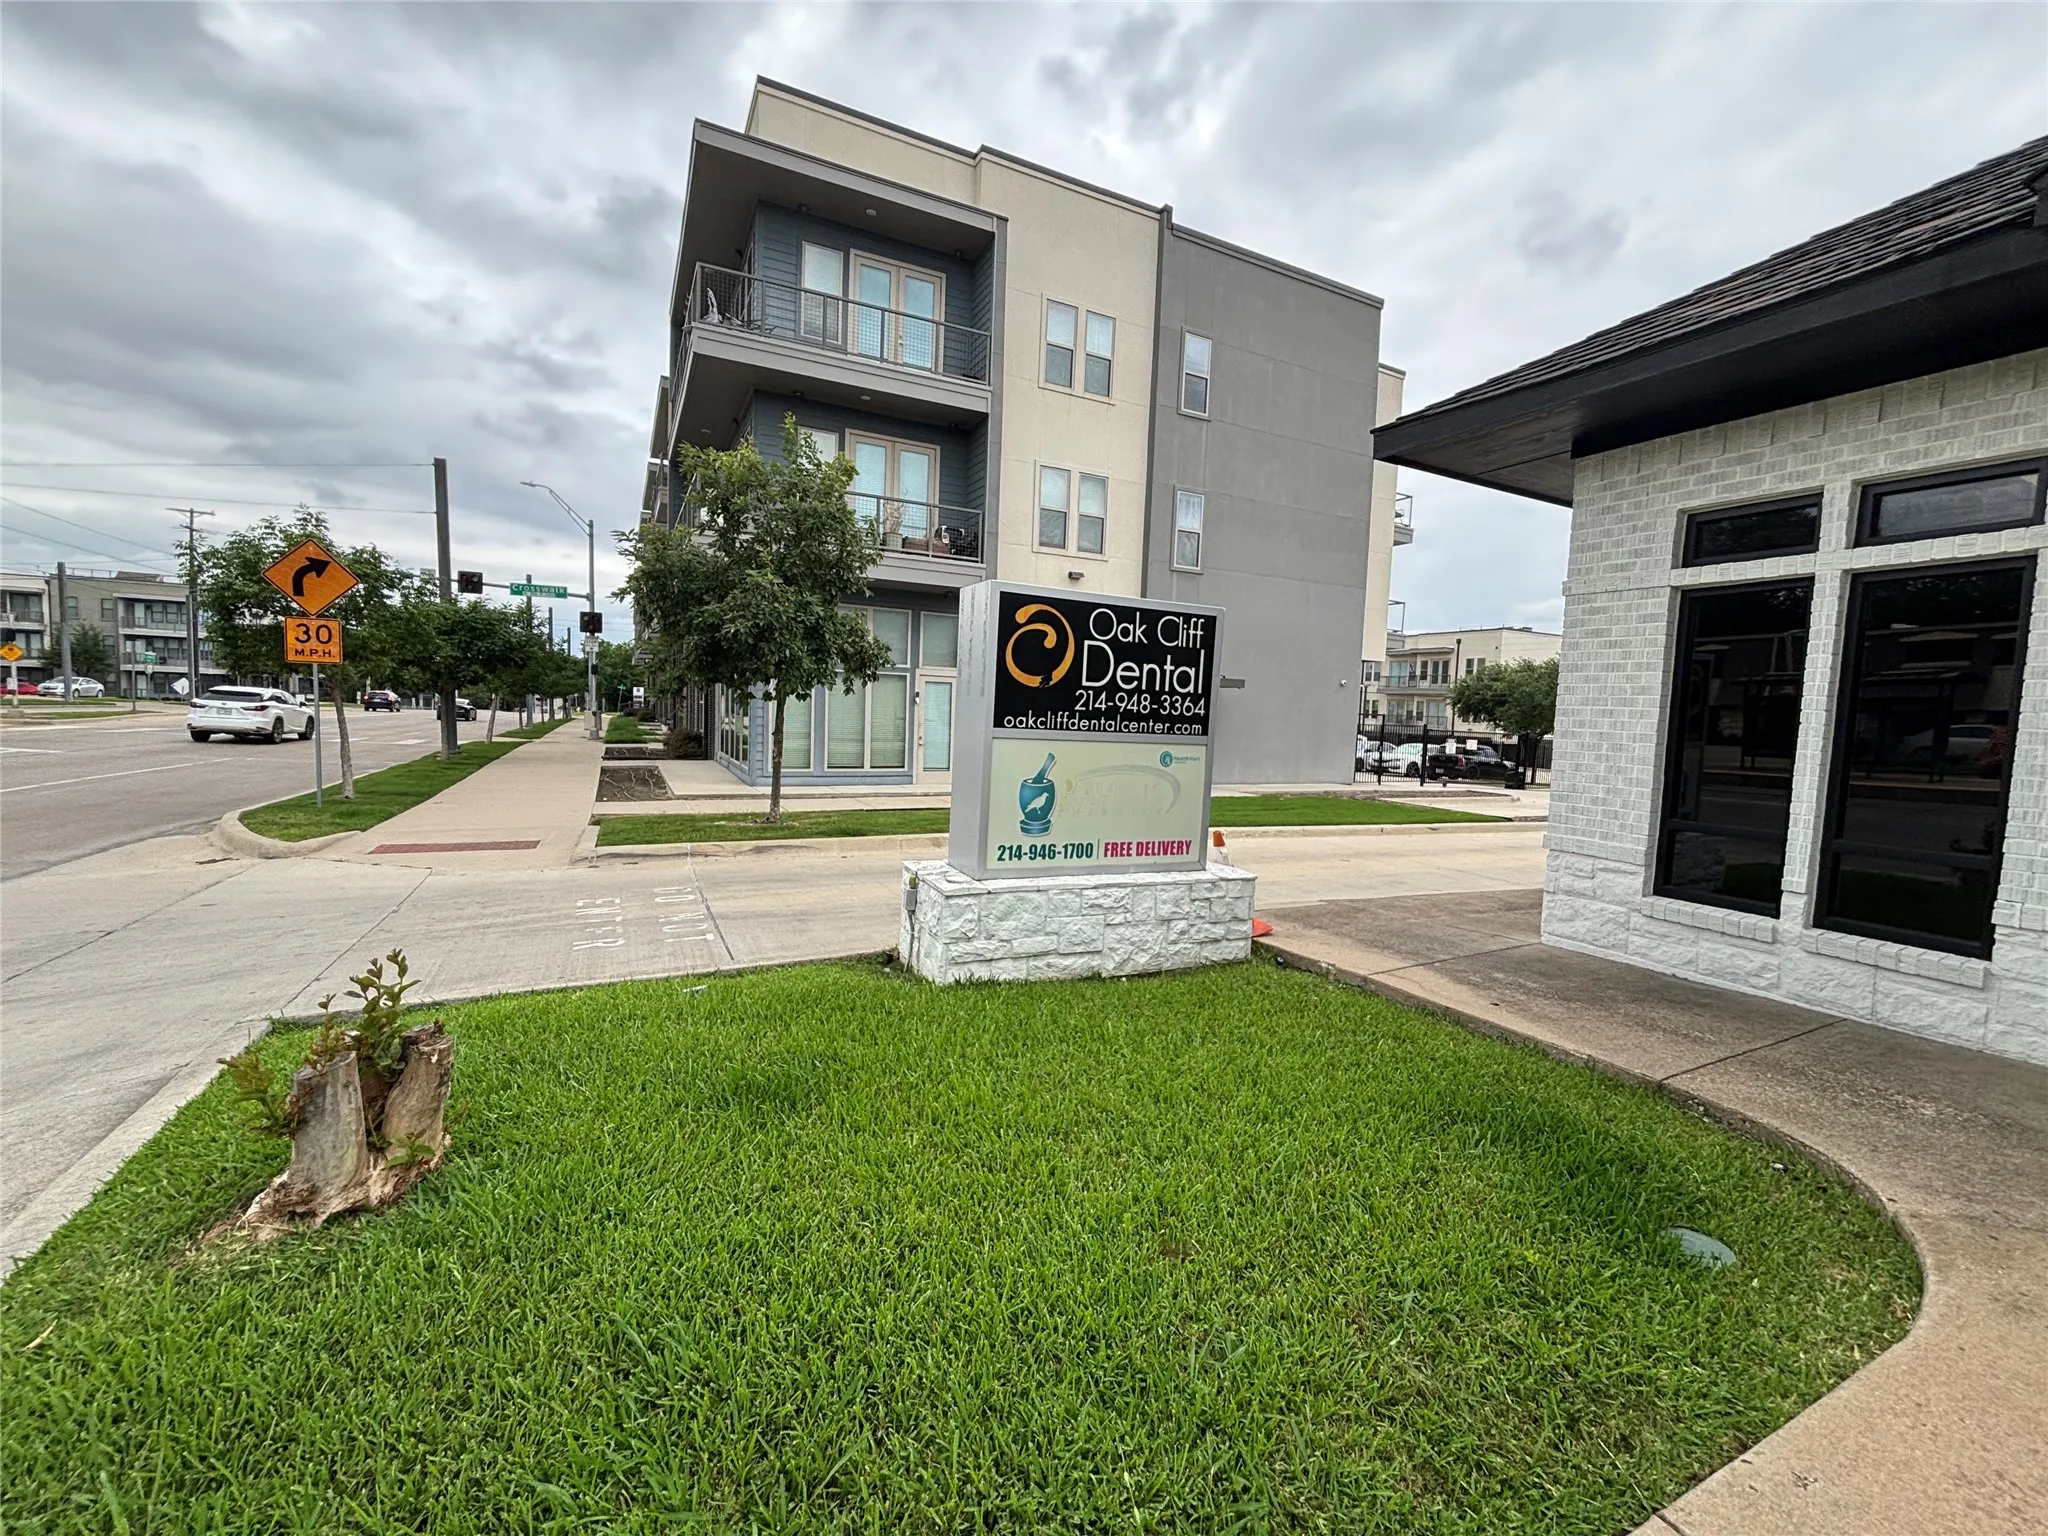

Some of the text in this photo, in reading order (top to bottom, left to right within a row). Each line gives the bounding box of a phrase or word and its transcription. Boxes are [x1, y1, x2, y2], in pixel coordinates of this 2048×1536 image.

[512, 584, 565, 594] Crosswalk
[294, 623, 333, 645] 30
[1089, 608, 1205, 649] Oak Cliff
[294, 648, 336, 659] M.P.H.
[1081, 640, 1205, 694] Dental
[1074, 690, 1206, 717] 214-948-3364
[1003, 710, 1203, 735] oakcliffdentalcenter.com
[997, 839, 1192, 862] 214-946-1700 FREE DELIVERY
